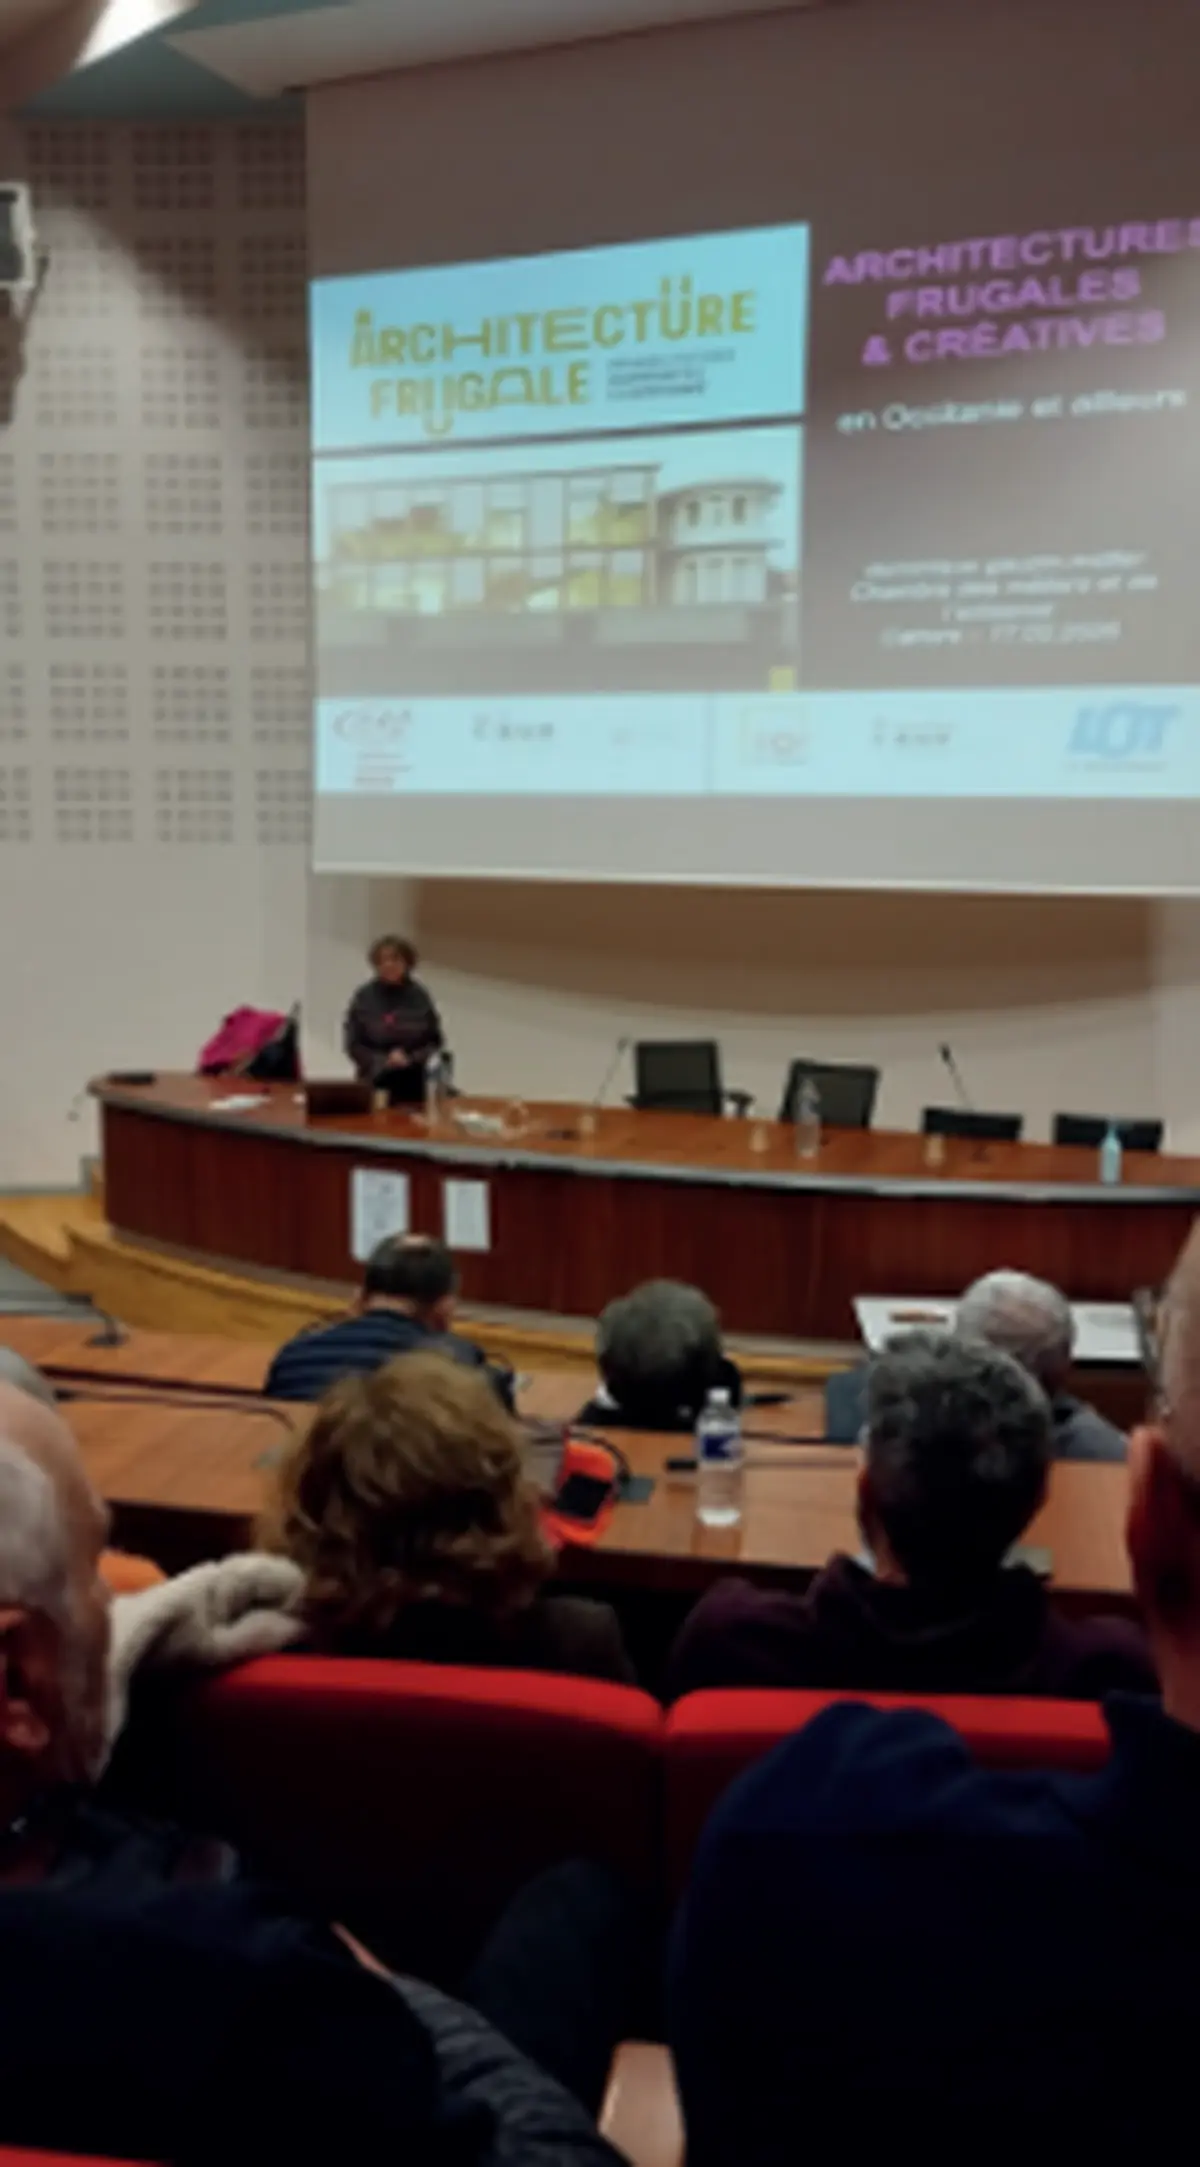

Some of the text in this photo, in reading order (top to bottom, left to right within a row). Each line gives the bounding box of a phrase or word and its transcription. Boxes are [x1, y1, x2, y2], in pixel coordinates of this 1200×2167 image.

[886, 266, 1141, 319] FRUGALES
[862, 309, 1166, 365] & CRÉATIVES
[370, 360, 593, 437] FRUGALE
[1066, 703, 1181, 757] LOT
